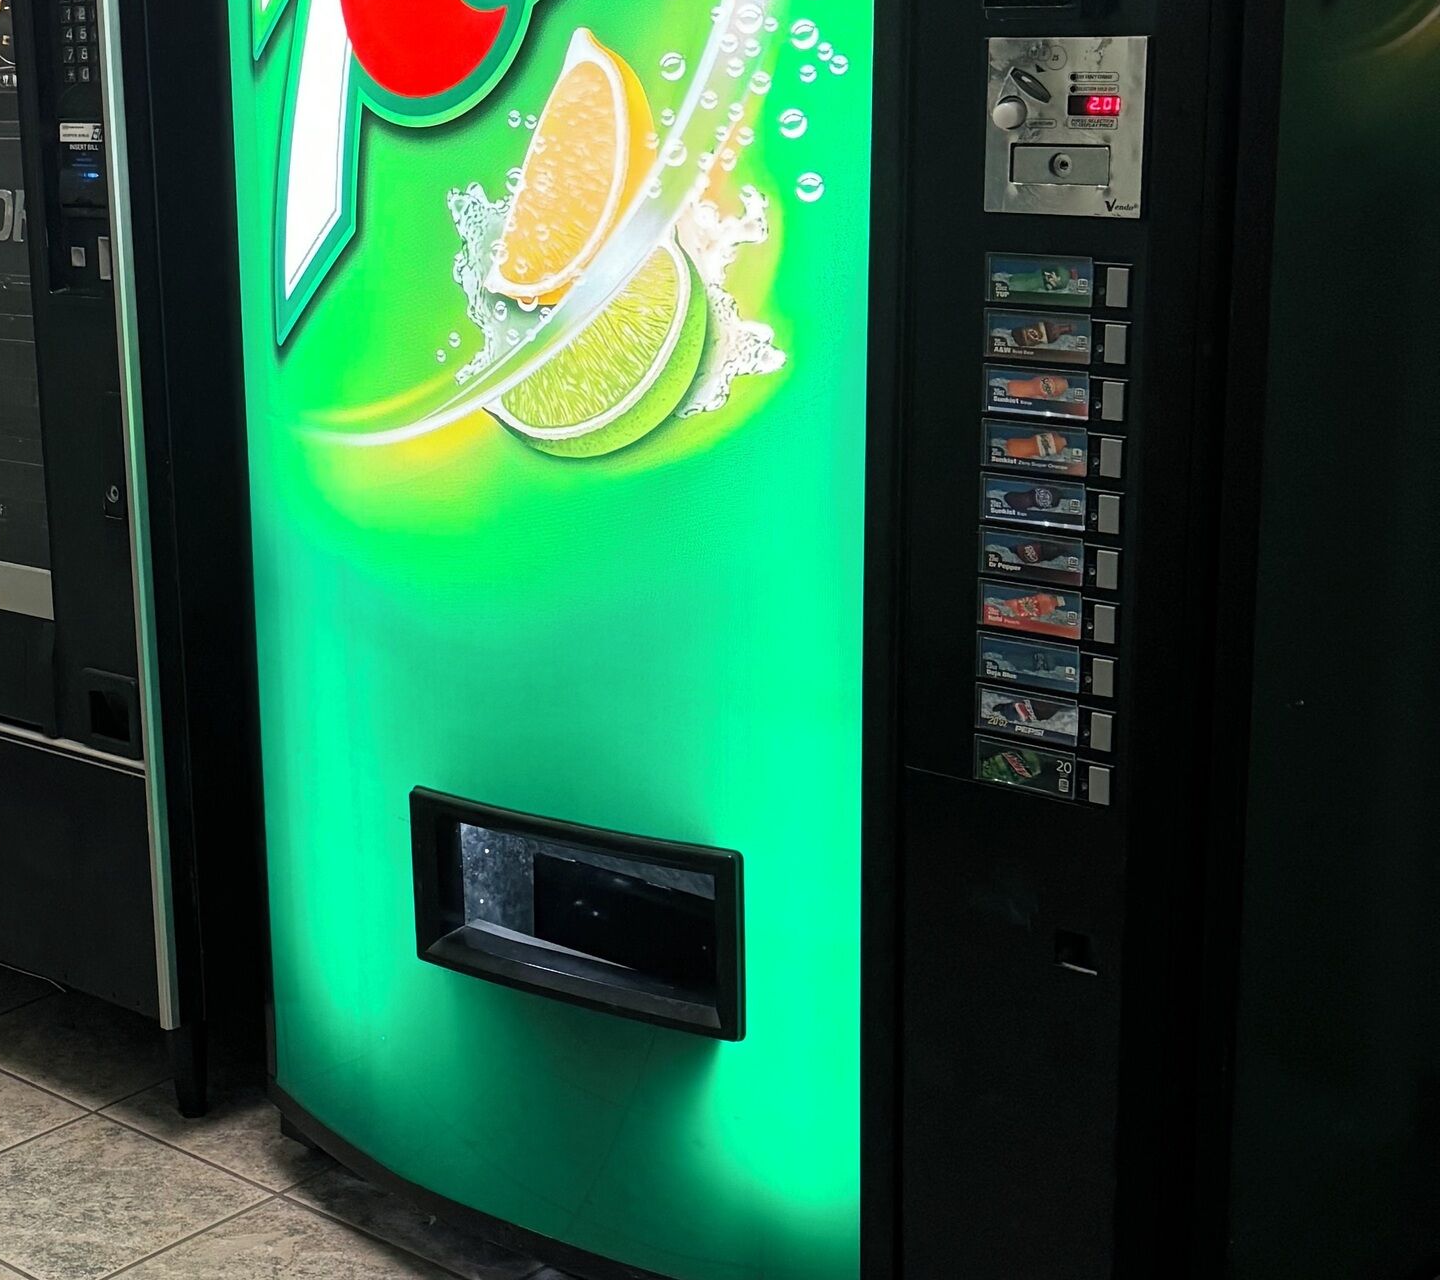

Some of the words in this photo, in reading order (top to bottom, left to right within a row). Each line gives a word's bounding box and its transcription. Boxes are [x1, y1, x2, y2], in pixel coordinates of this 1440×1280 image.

[66, 28, 72, 40] 4
[80, 28, 87, 40] 5
[68, 49, 74, 60] 7
[81, 48, 88, 60] 8
[993, 396, 1020, 404] Sunkist
[992, 456, 1016, 464] Sunkist
[998, 562, 1022, 571] Pepper
[1015, 725, 1044, 736] PEPSI
[1056, 760, 1072, 774] 20
